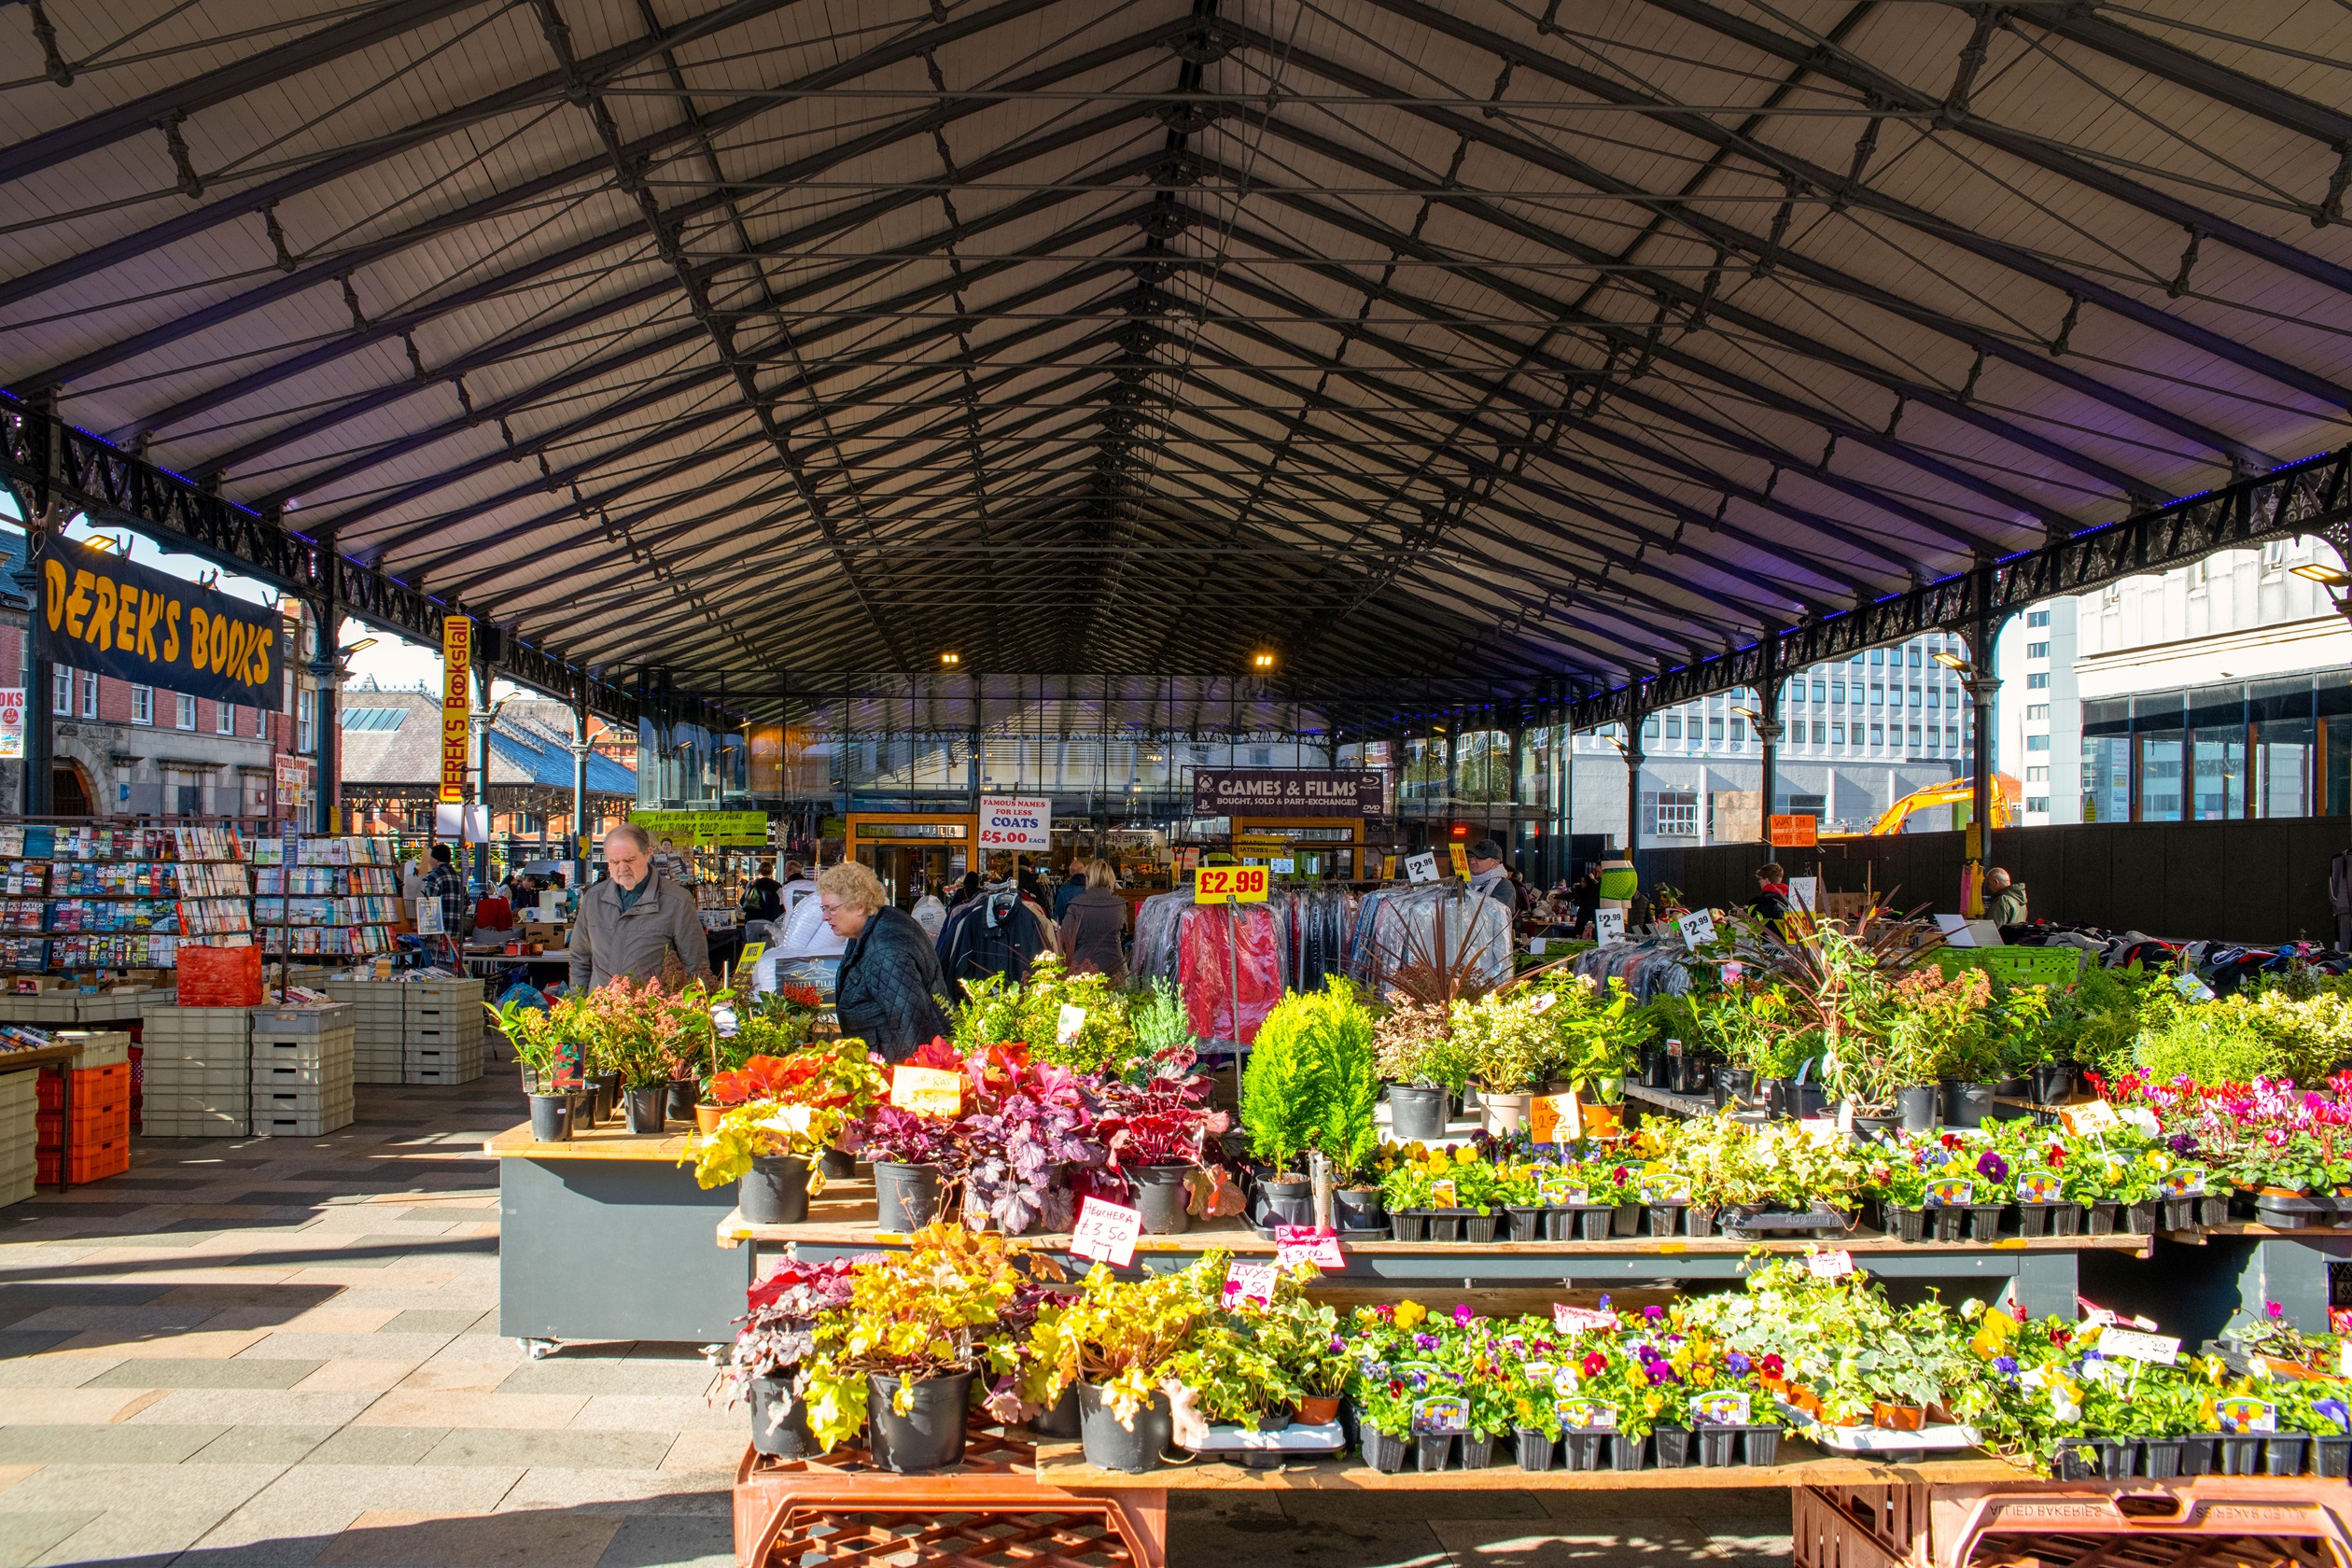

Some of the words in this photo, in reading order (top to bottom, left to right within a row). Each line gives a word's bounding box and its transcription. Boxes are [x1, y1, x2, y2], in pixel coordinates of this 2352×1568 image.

[45, 558, 181, 663] DEREK'S
[189, 607, 273, 688] BOOKS
[446, 621, 468, 709] Bookstall
[276, 757, 293, 769] PUZZLE
[293, 760, 308, 772] BOOKS
[443, 718, 467, 797] DEREK'S
[1218, 780, 1281, 796] GAMES
[1286, 780, 1300, 796] &
[1305, 780, 1357, 796] FILMS
[983, 799, 1016, 807] FAMOUS
[1283, 798, 1358, 806] PART-EXCHANGED
[637, 819, 652, 827] TOP
[653, 812, 671, 820] THE
[674, 812, 696, 820] BOOK
[699, 812, 724, 820] STOPS
[991, 817, 1039, 829] COATS
[1774, 817, 1806, 827] WATCH
[668, 823, 696, 832] BOOKS
[981, 830, 1028, 845] £5.00
[1408, 857, 1434, 875] £2.99
[1200, 870, 1264, 894] £2.99
[1790, 880, 1811, 891] MENS
[1598, 913, 1621, 928] £2.99
[1683, 915, 1709, 936] £2.99
[745, 945, 760, 957] HOTEL
[1532, 1113, 1566, 1131] £2.50
[1084, 1200, 1135, 1225] HEUCHERA
[1080, 1218, 1127, 1241] £3.50
[1282, 1250, 1323, 1264] £3.00
[1233, 1265, 1272, 1280] IVYS
